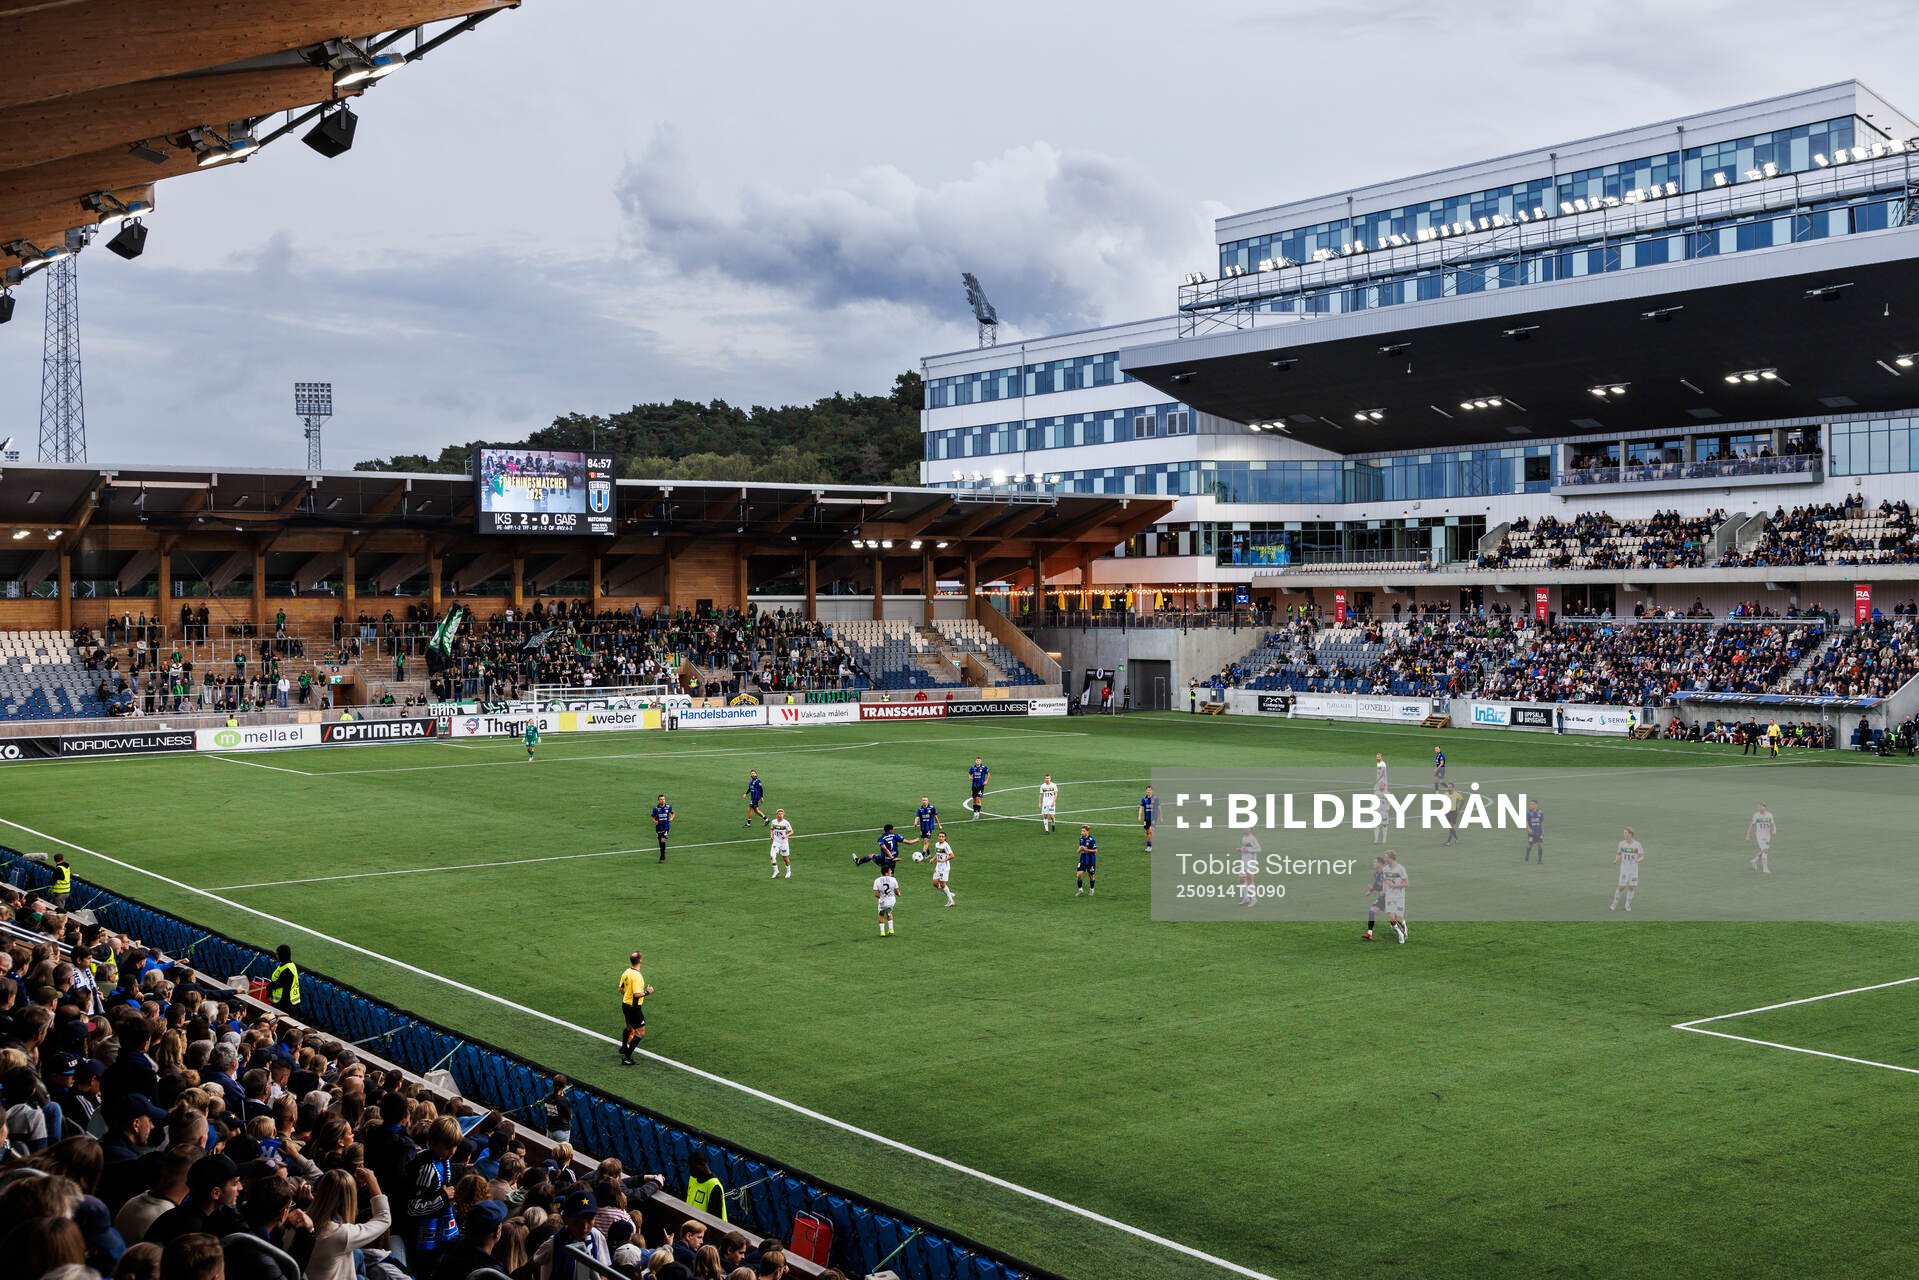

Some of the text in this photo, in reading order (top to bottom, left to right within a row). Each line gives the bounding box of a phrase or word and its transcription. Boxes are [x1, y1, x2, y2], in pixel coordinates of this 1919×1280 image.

[587, 458, 612, 469] 84:57
[499, 475, 567, 489] FÖRENINGSMATCHEN
[527, 488, 544, 500] 2025
[494, 513, 512, 525] IKS
[520, 513, 528, 525] 2
[541, 513, 550, 525] 0
[554, 513, 577, 526] GAIS
[1855, 590, 1870, 598] RA
[680, 708, 757, 720] Handelsbanken
[800, 710, 826, 719] Vaksala
[828, 709, 849, 718] måleri
[862, 704, 945, 719] TRANSSCHAKT
[948, 702, 1028, 713] NORDICWELLNESS
[594, 711, 637, 725] weber
[244, 728, 287, 744] mella
[332, 721, 426, 741] OPTIMERA
[63, 735, 193, 752] NORDICWELLNESS
[887, 840, 893, 851] 7
[882, 883, 891, 896] 2
